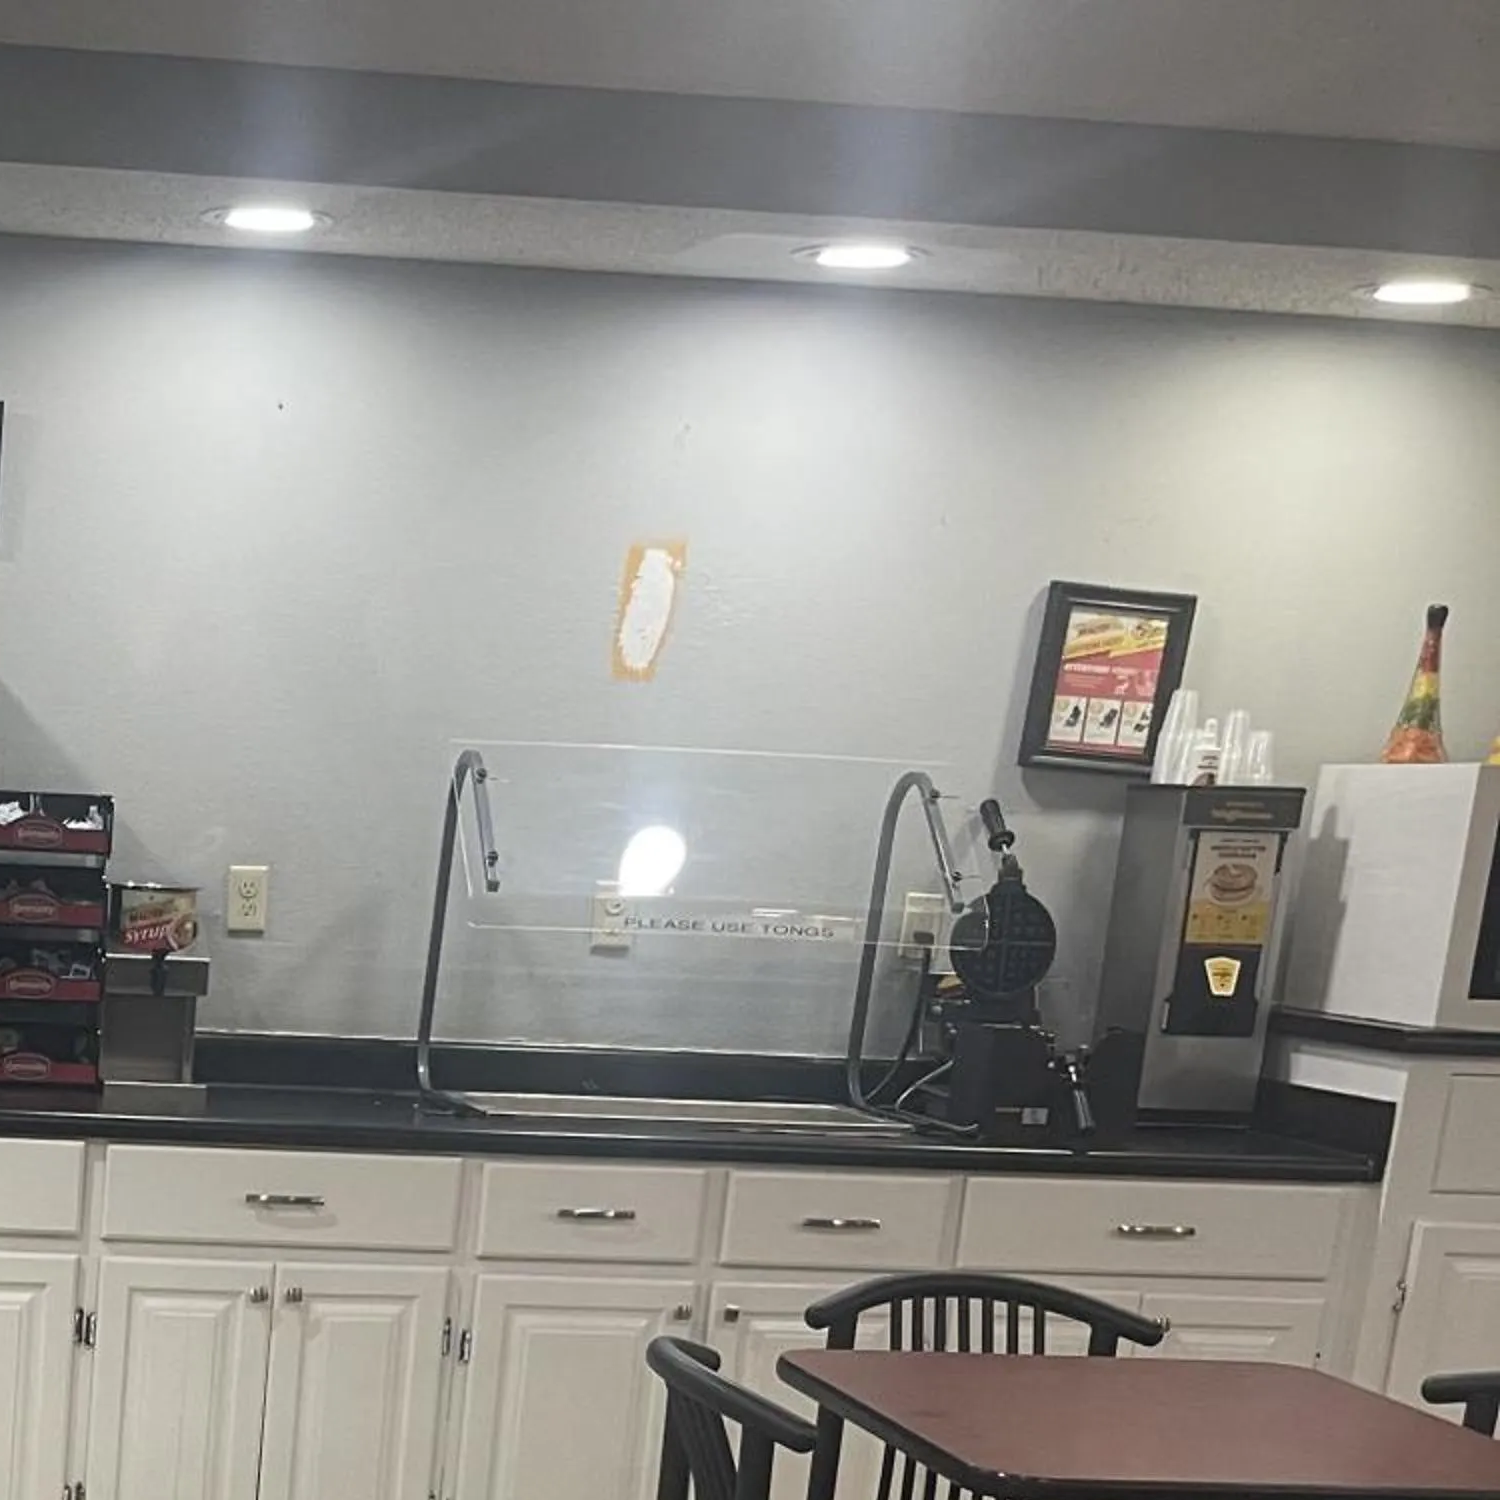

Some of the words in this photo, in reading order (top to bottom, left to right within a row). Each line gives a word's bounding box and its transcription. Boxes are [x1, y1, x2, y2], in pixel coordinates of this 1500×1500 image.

[624, 917, 704, 931] PLEASE
[711, 921, 753, 933] USE
[762, 923, 835, 938] TONGS
